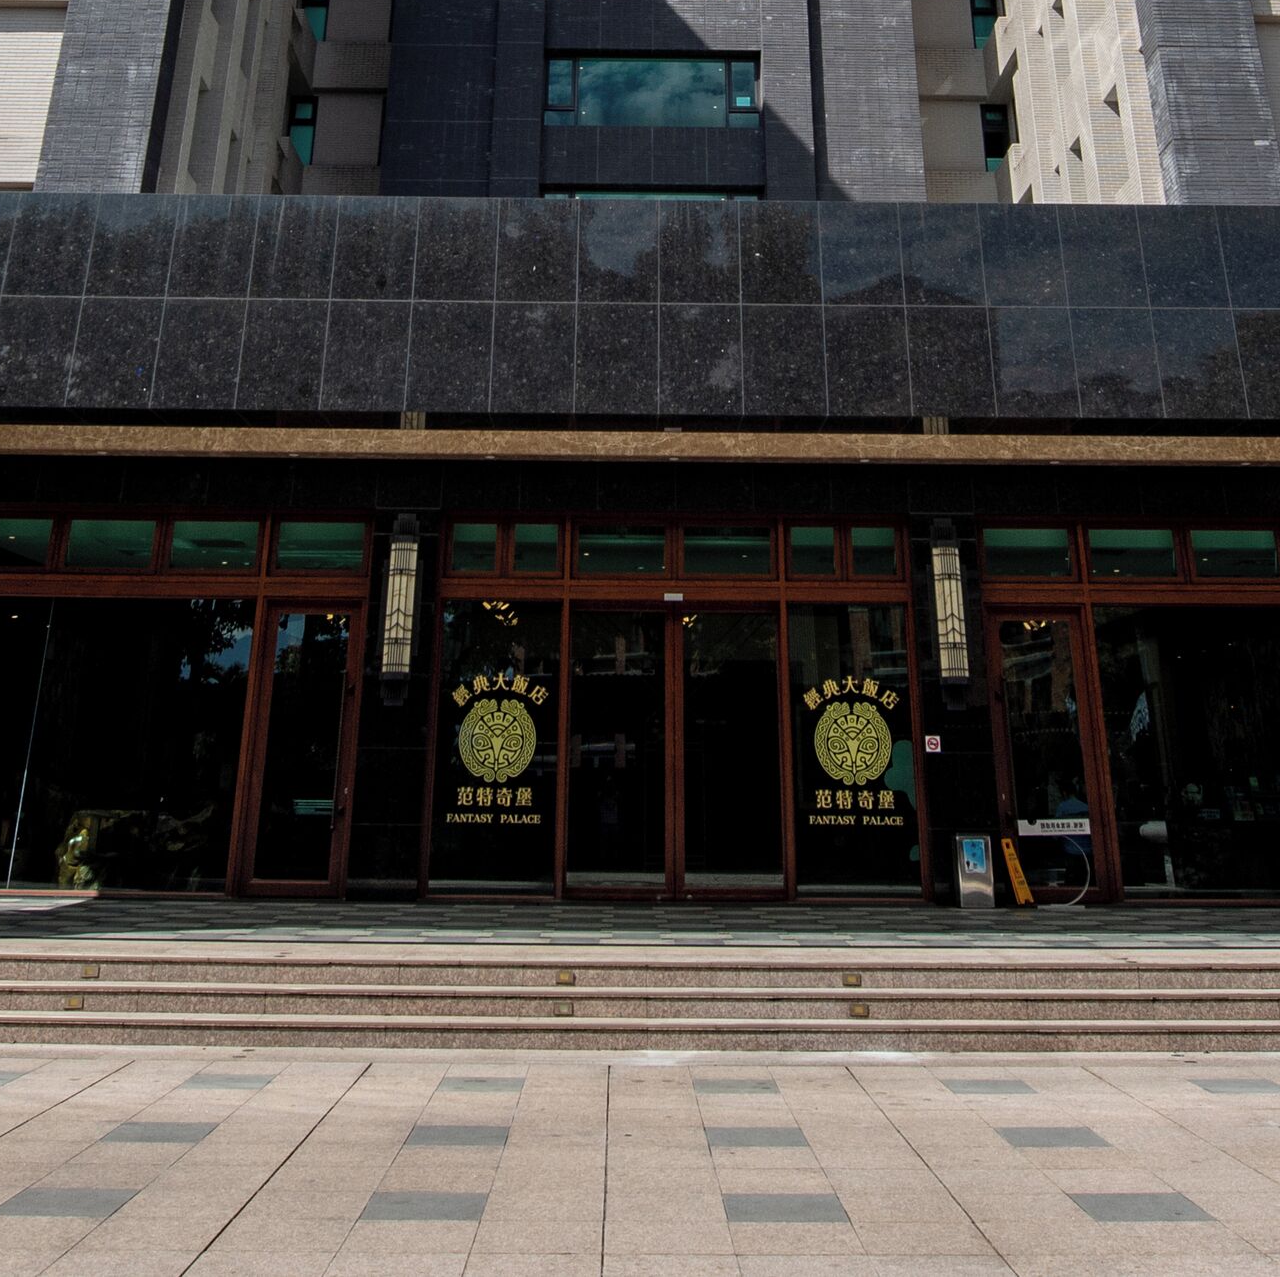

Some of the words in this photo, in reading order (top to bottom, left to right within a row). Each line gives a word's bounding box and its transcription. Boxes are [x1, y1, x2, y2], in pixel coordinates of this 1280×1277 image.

[452, 672, 549, 708] 經典大飯店
[803, 675, 900, 711] 經典大飯店
[457, 786, 533, 807] 范特奇堡
[815, 789, 895, 810] 范特奇堡
[446, 813, 494, 823] FANTASY
[500, 814, 541, 824] PALACE
[809, 815, 857, 825] FANTASY
[862, 816, 904, 826] PALACE
